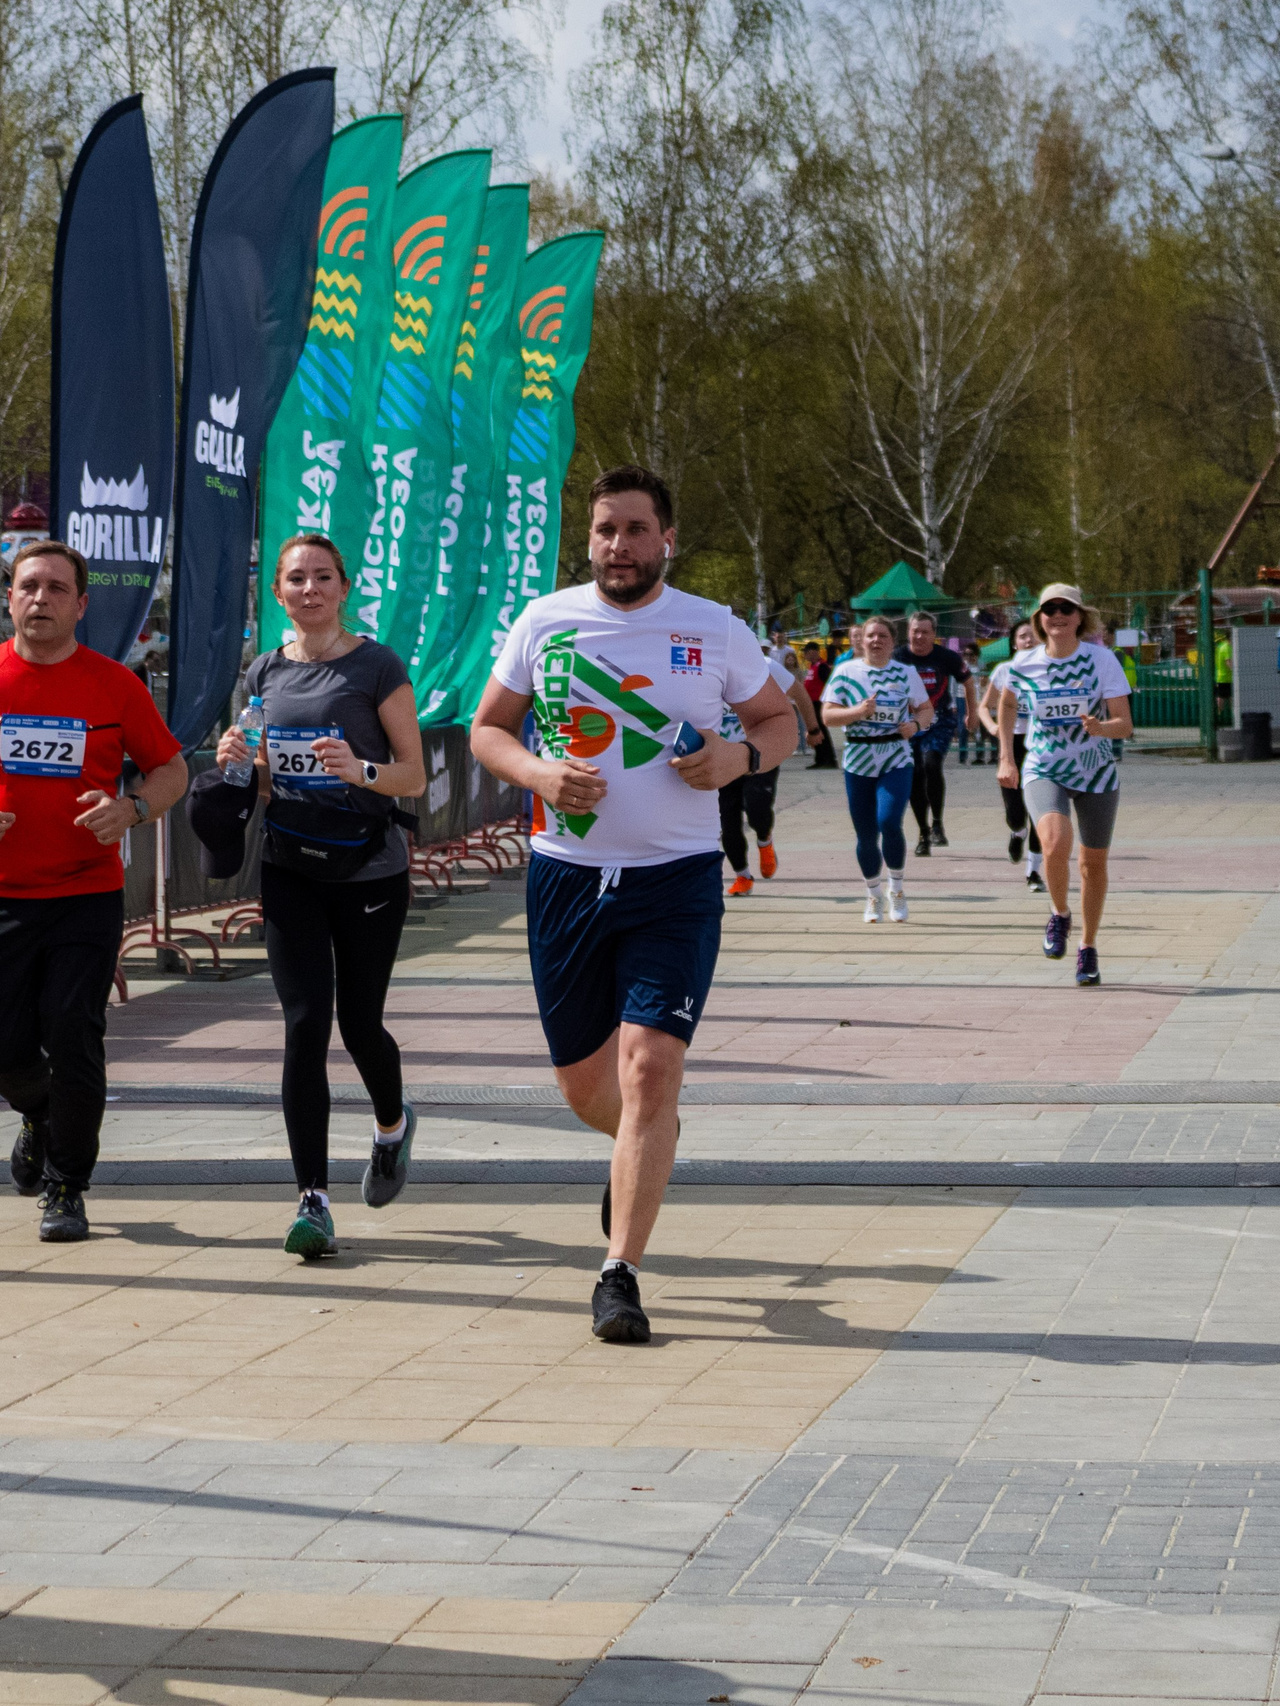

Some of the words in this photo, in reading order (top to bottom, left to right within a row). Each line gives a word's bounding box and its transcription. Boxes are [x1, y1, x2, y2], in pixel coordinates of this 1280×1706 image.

[67, 511, 163, 564] GORILLA
[387, 447, 419, 592] ГРОЗА
[521, 477, 548, 599] ГРОЗА
[1045, 703, 1080, 717] 2187
[9, 739, 74, 762] 2672
[277, 753, 327, 773] 267
